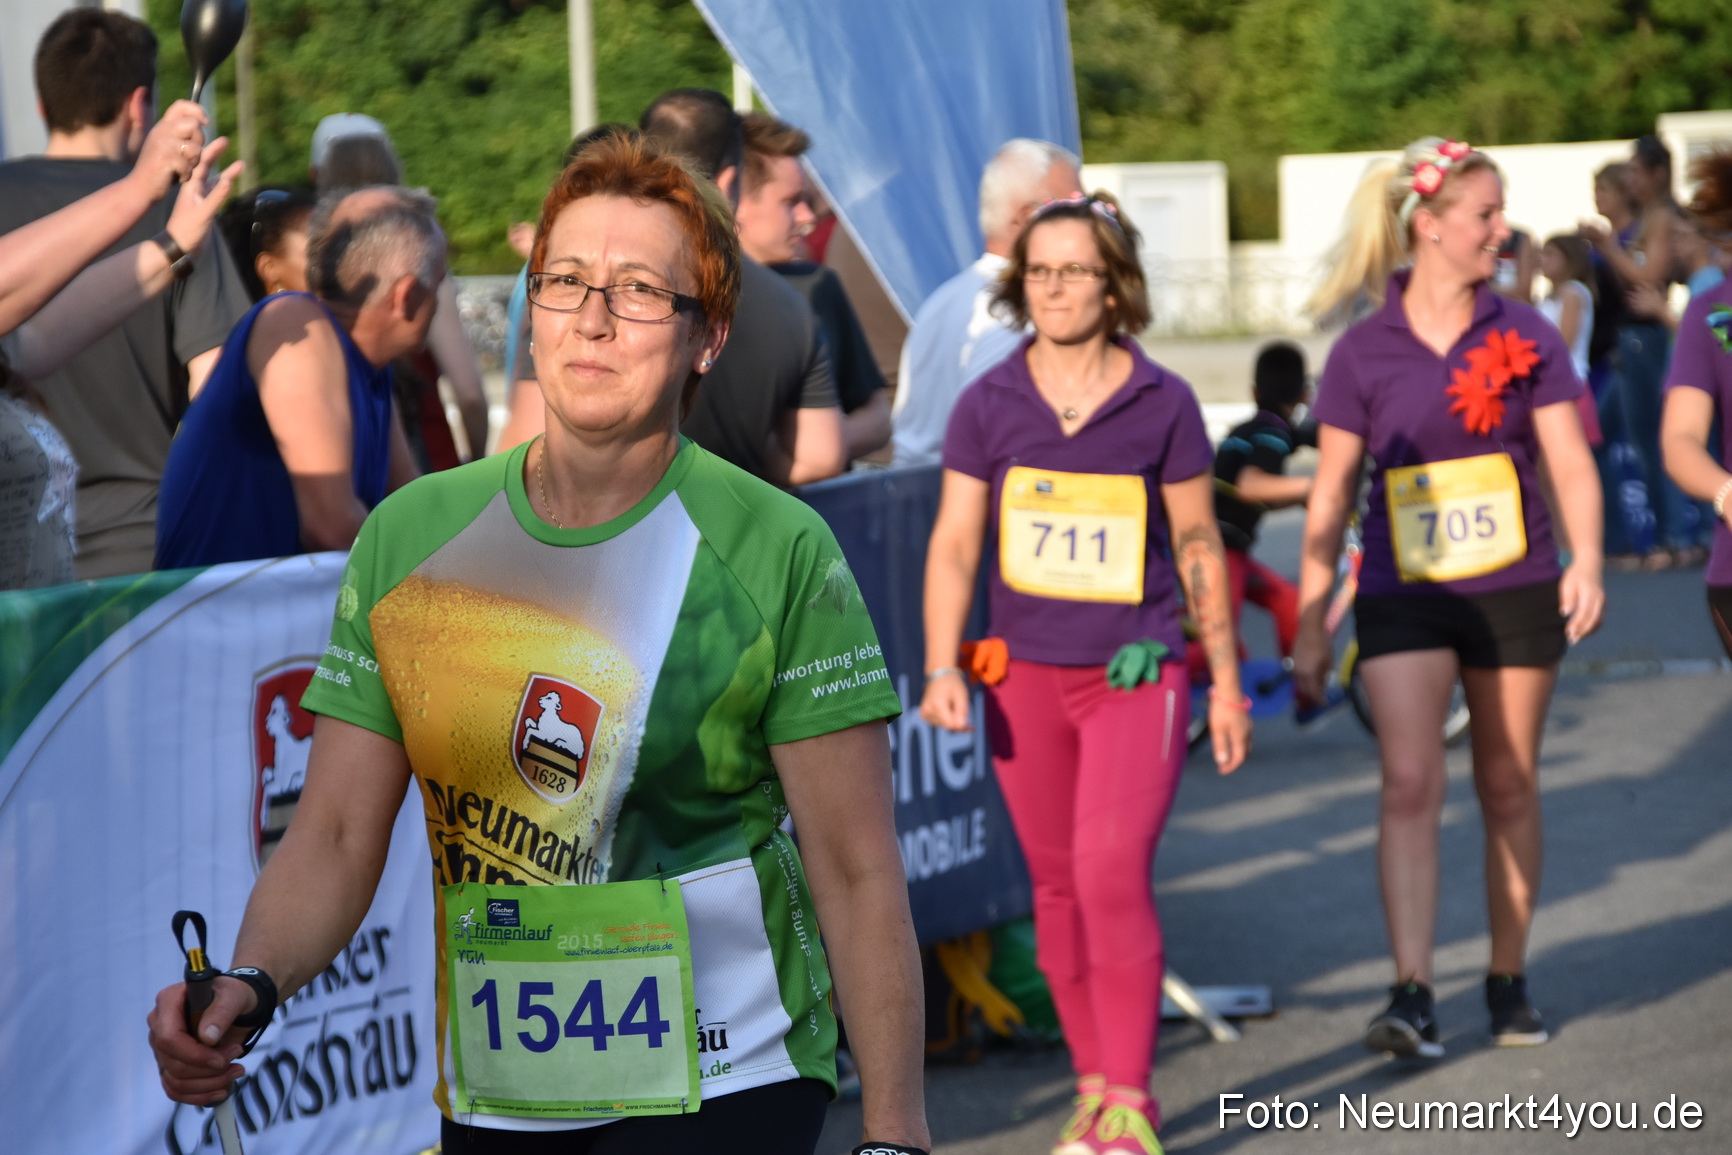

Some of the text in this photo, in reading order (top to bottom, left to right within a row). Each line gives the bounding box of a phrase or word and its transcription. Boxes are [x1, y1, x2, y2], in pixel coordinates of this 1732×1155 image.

[1031, 522, 1106, 563] 711
[1417, 505, 1497, 547] 705
[531, 764, 567, 794] 1628
[475, 922, 553, 941] firmenlauf
[557, 934, 604, 950] 2015
[471, 976, 670, 1053] 1544
